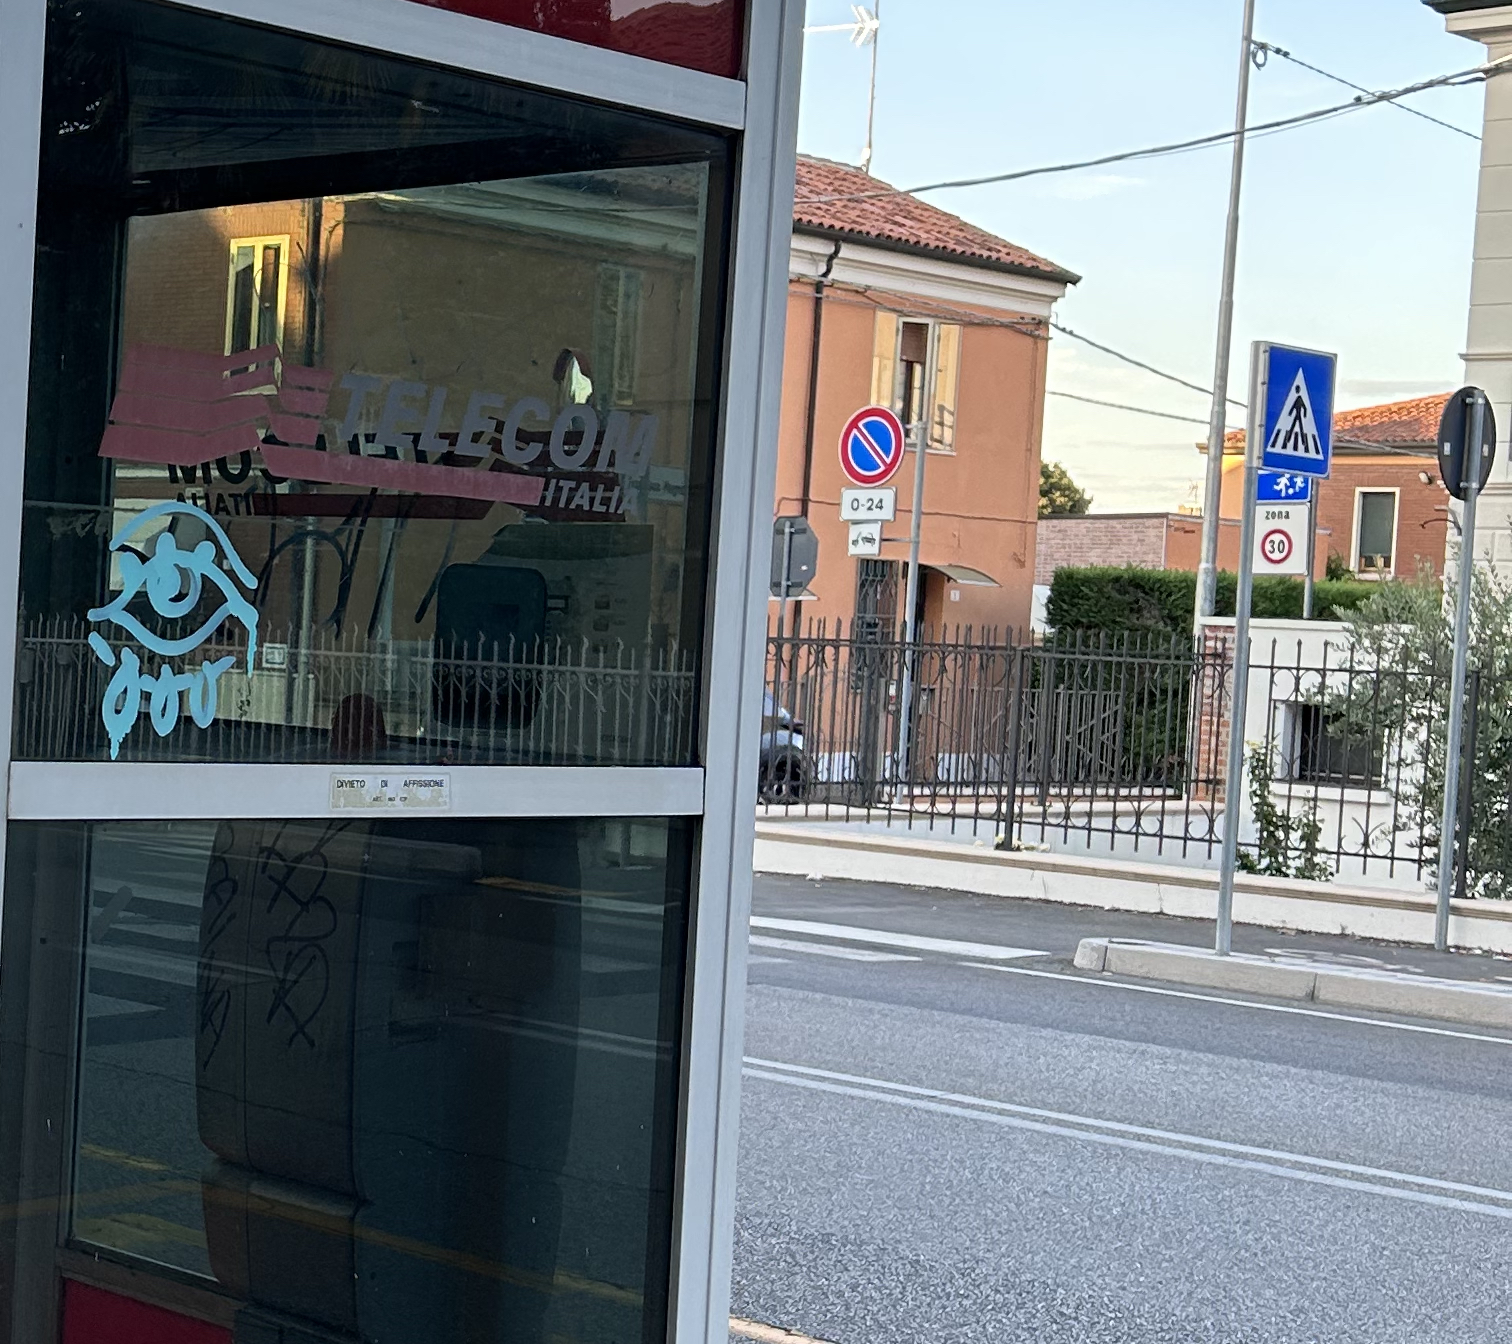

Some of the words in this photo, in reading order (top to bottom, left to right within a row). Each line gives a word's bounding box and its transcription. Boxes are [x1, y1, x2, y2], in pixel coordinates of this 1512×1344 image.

[337, 374, 659, 478] TELECOM
[536, 477, 639, 517] ITALIA
[850, 497, 884, 512] 0-24
[1265, 510, 1290, 521] zona
[1268, 539, 1286, 554] 30
[336, 779, 366, 789] DIVIETO
